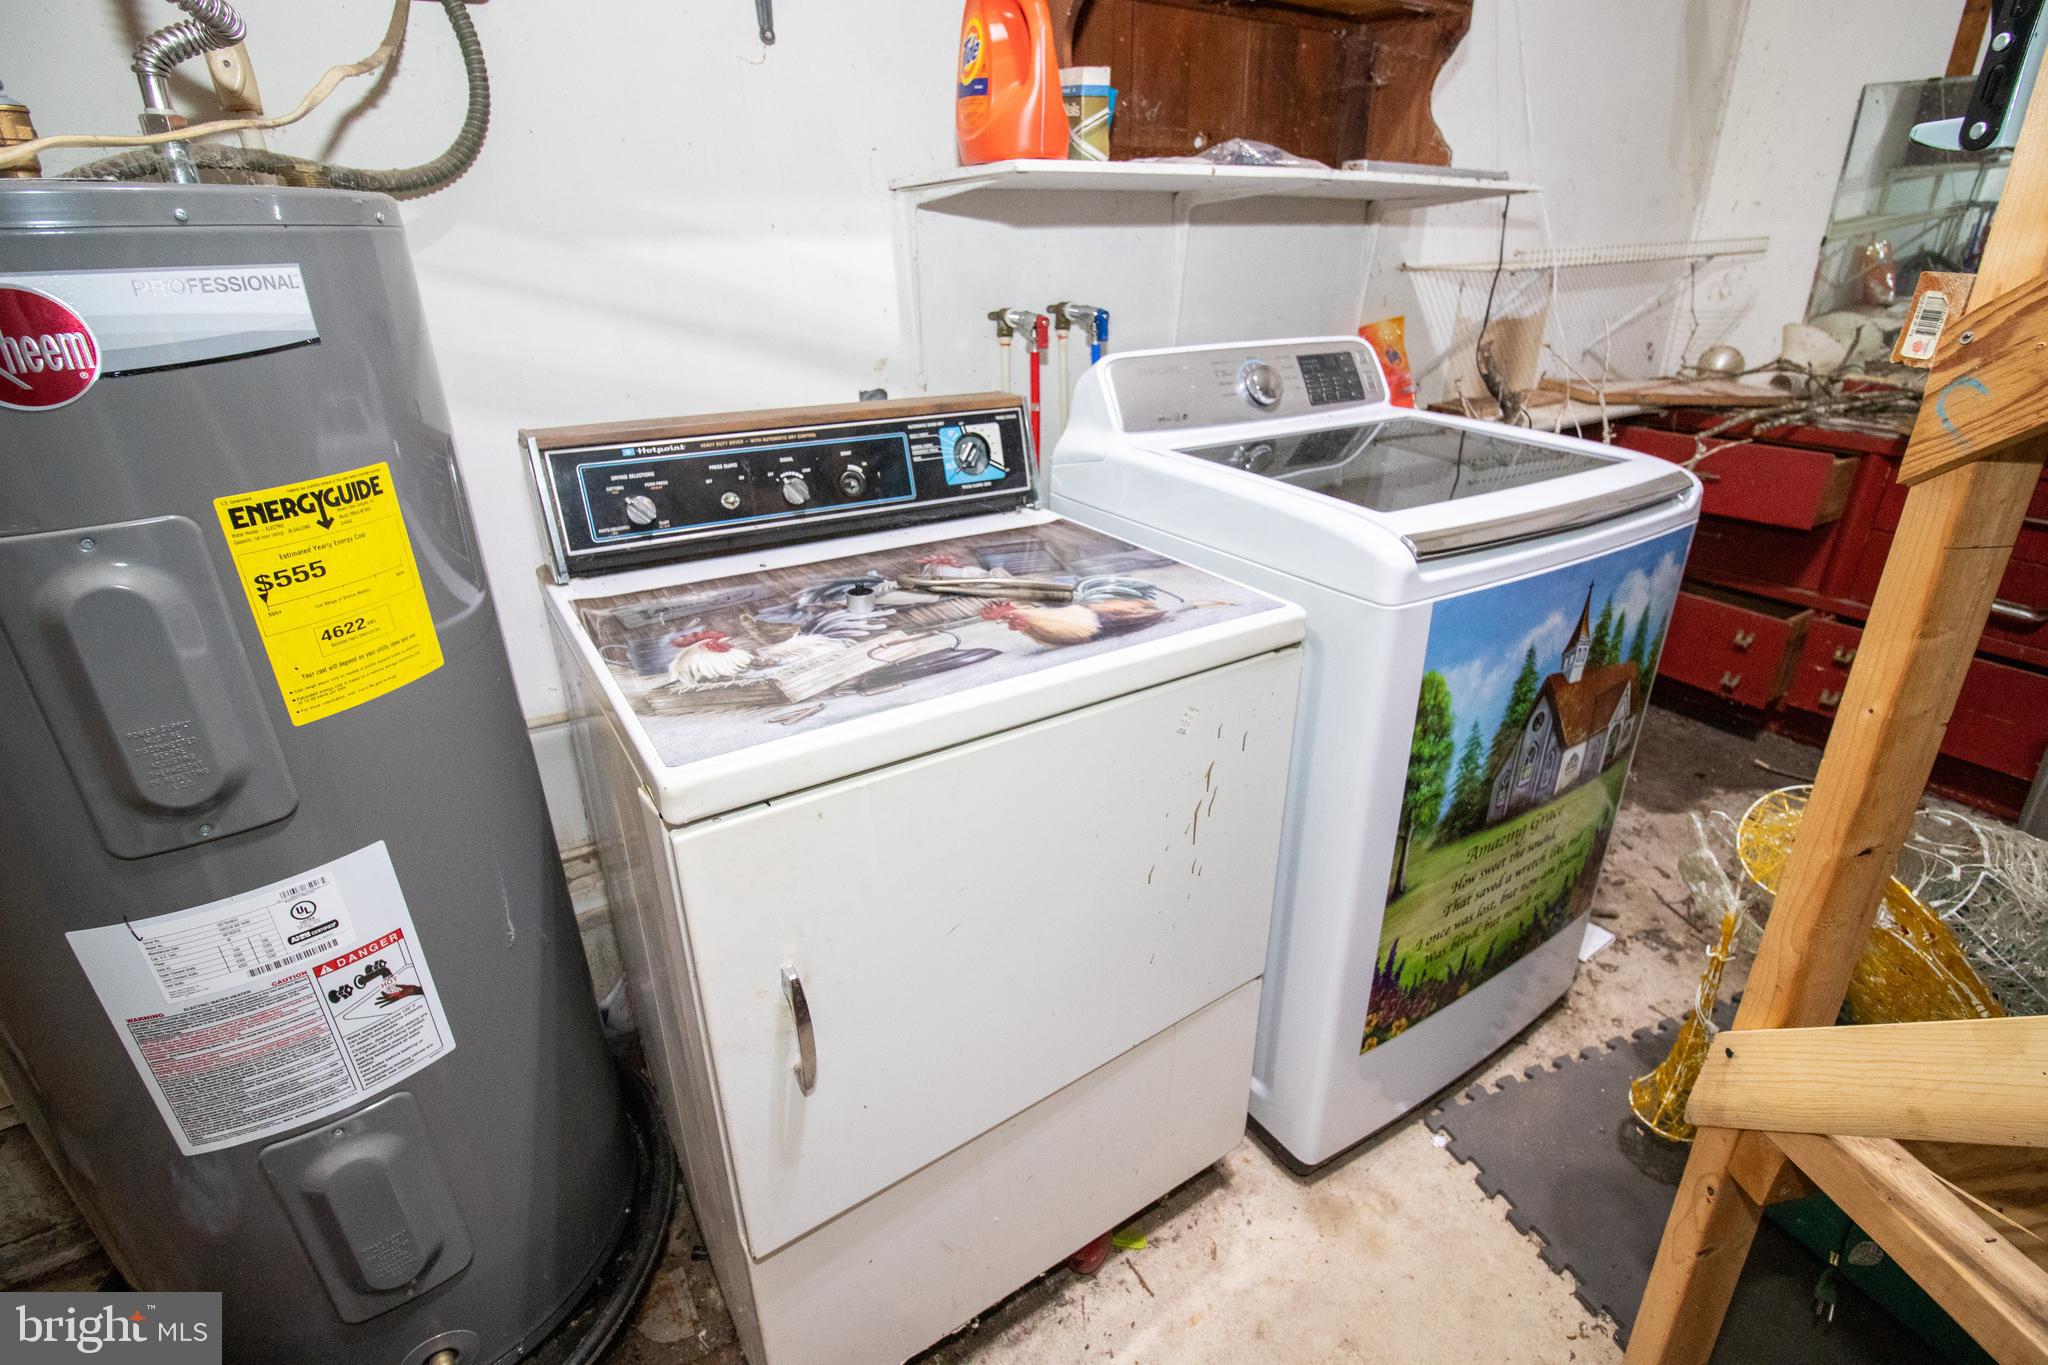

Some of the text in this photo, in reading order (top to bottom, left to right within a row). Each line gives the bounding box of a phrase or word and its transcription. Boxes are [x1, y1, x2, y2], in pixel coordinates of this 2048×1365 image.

[132, 274, 300, 296] PROFESSIONAL
[0, 330, 95, 376] heem
[636, 444, 685, 454] Hotpoint
[227, 476, 383, 530] ENERGYGUIDE
[280, 532, 366, 559] Estimated Yearly Energy Cost
[254, 560, 326, 592] $555
[322, 618, 366, 642] 4622
[301, 672, 315, 680] Your
[316, 667, 327, 675] cost
[339, 656, 357, 668] depend
[1466, 804, 1565, 864] Amazing Grace
[1442, 896, 1472, 918] That
[1474, 872, 1506, 900] saved
[1506, 874, 1512, 884] a
[1515, 848, 1546, 877] wretch
[1549, 843, 1565, 859] like
[1451, 872, 1476, 894] How
[1480, 857, 1506, 877] sweet
[1509, 848, 1525, 863] the
[1416, 938, 1423, 951] I
[1426, 926, 1451, 946] once
[1454, 914, 1473, 929] was
[1477, 901, 1496, 918] lost,
[1500, 888, 1517, 904] but
[1520, 879, 1537, 891] now
[1425, 949, 1446, 964] Was
[1483, 916, 1501, 932] but
[1504, 904, 1521, 920] now
[336, 933, 398, 968] DANGER
[271, 971, 307, 987] CAUTION
[381, 976, 398, 988] HOT
[184, 1002, 210, 1012] ELECTRIC
[230, 990, 251, 999] HEATER
[127, 1012, 165, 1023] WARNING
